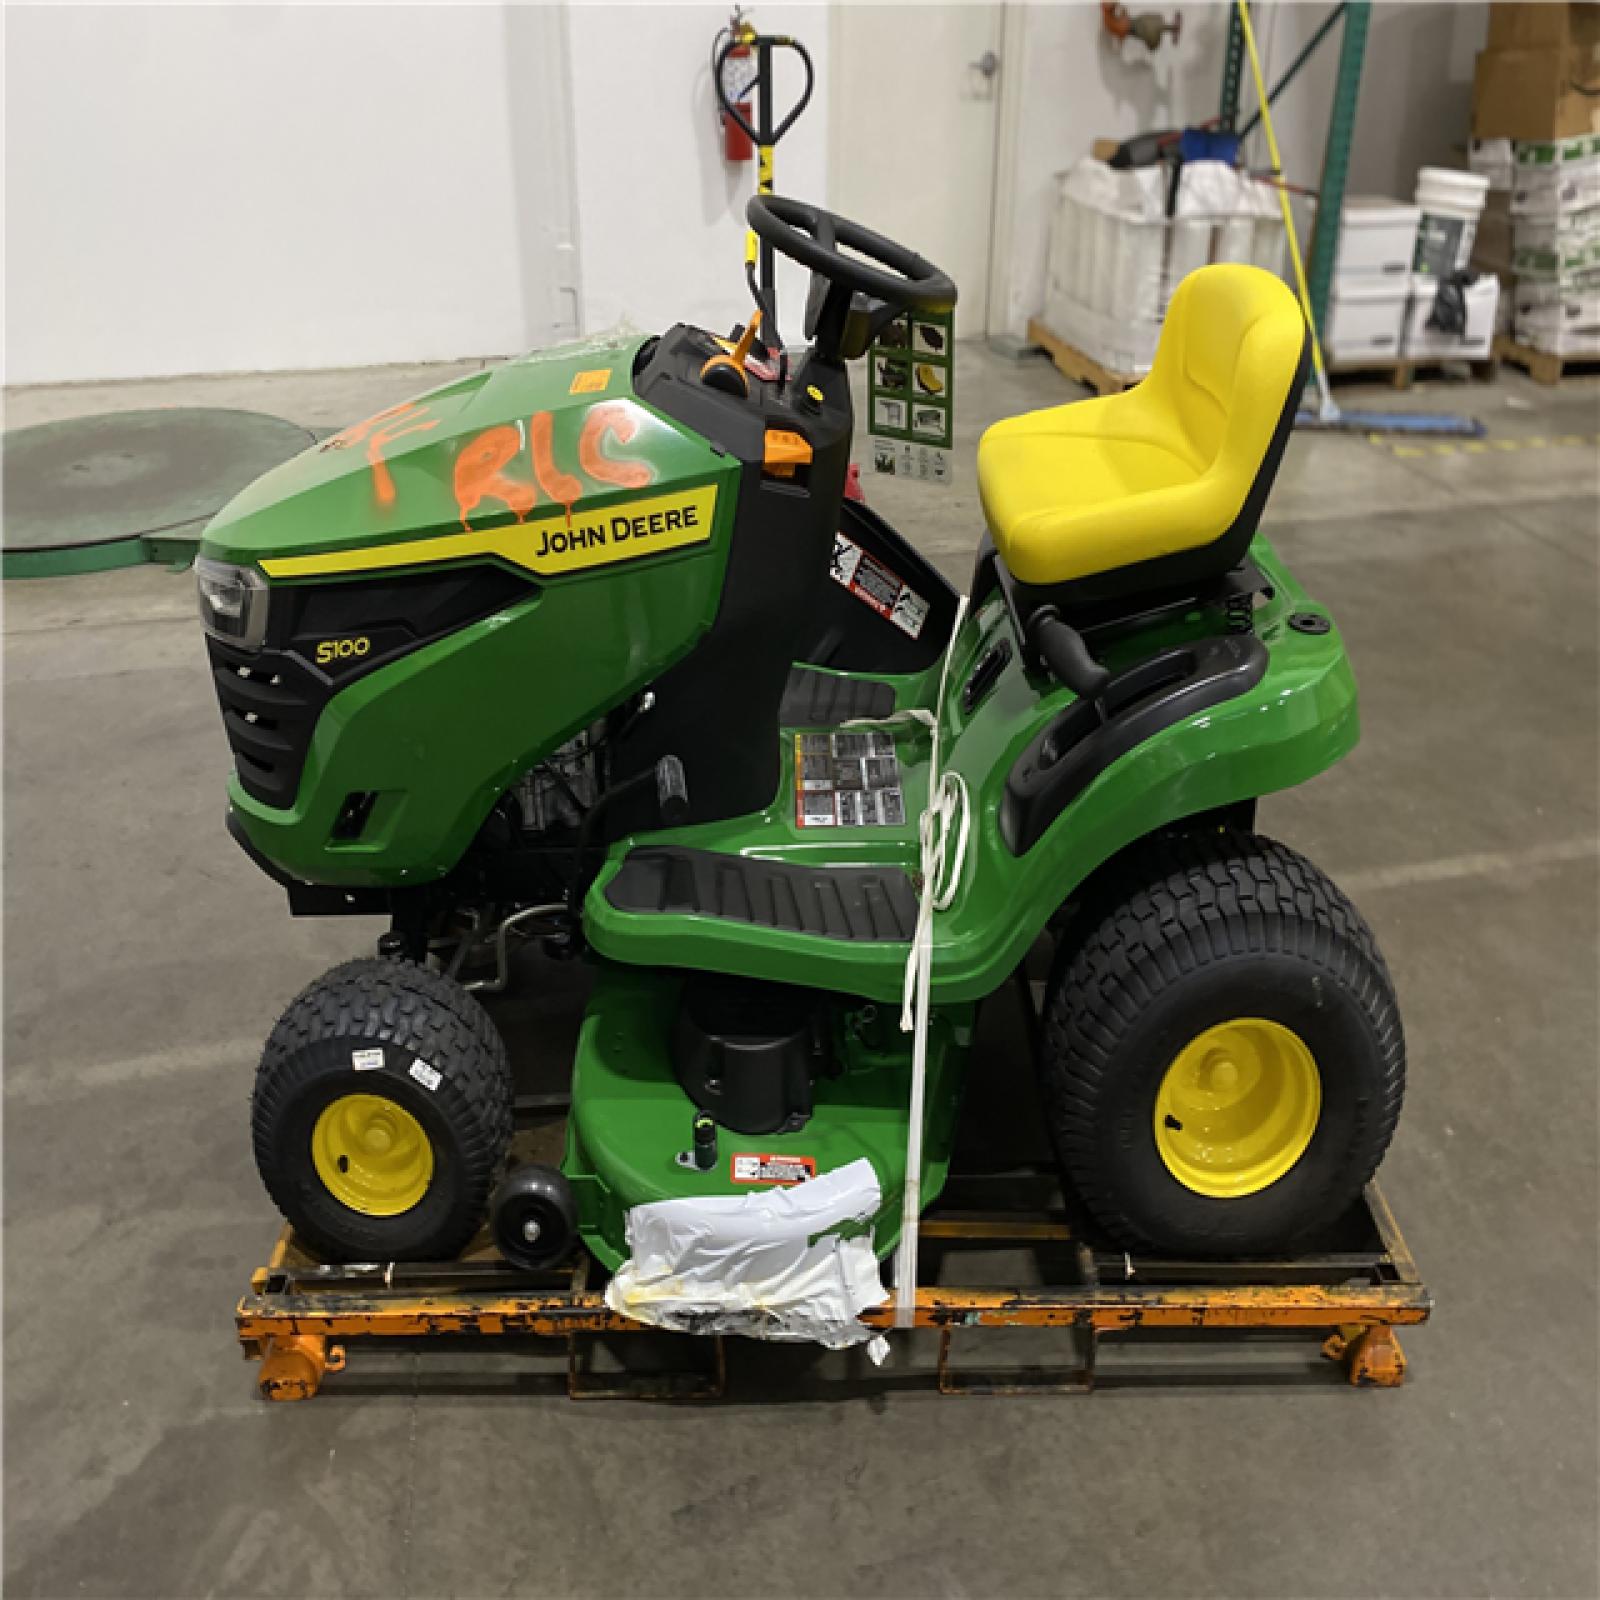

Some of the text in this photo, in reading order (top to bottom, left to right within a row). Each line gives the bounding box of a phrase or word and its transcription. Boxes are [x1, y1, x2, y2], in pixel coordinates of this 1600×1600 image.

[536, 504, 699, 557] JOHN DEERE
[315, 636, 370, 664] S100
